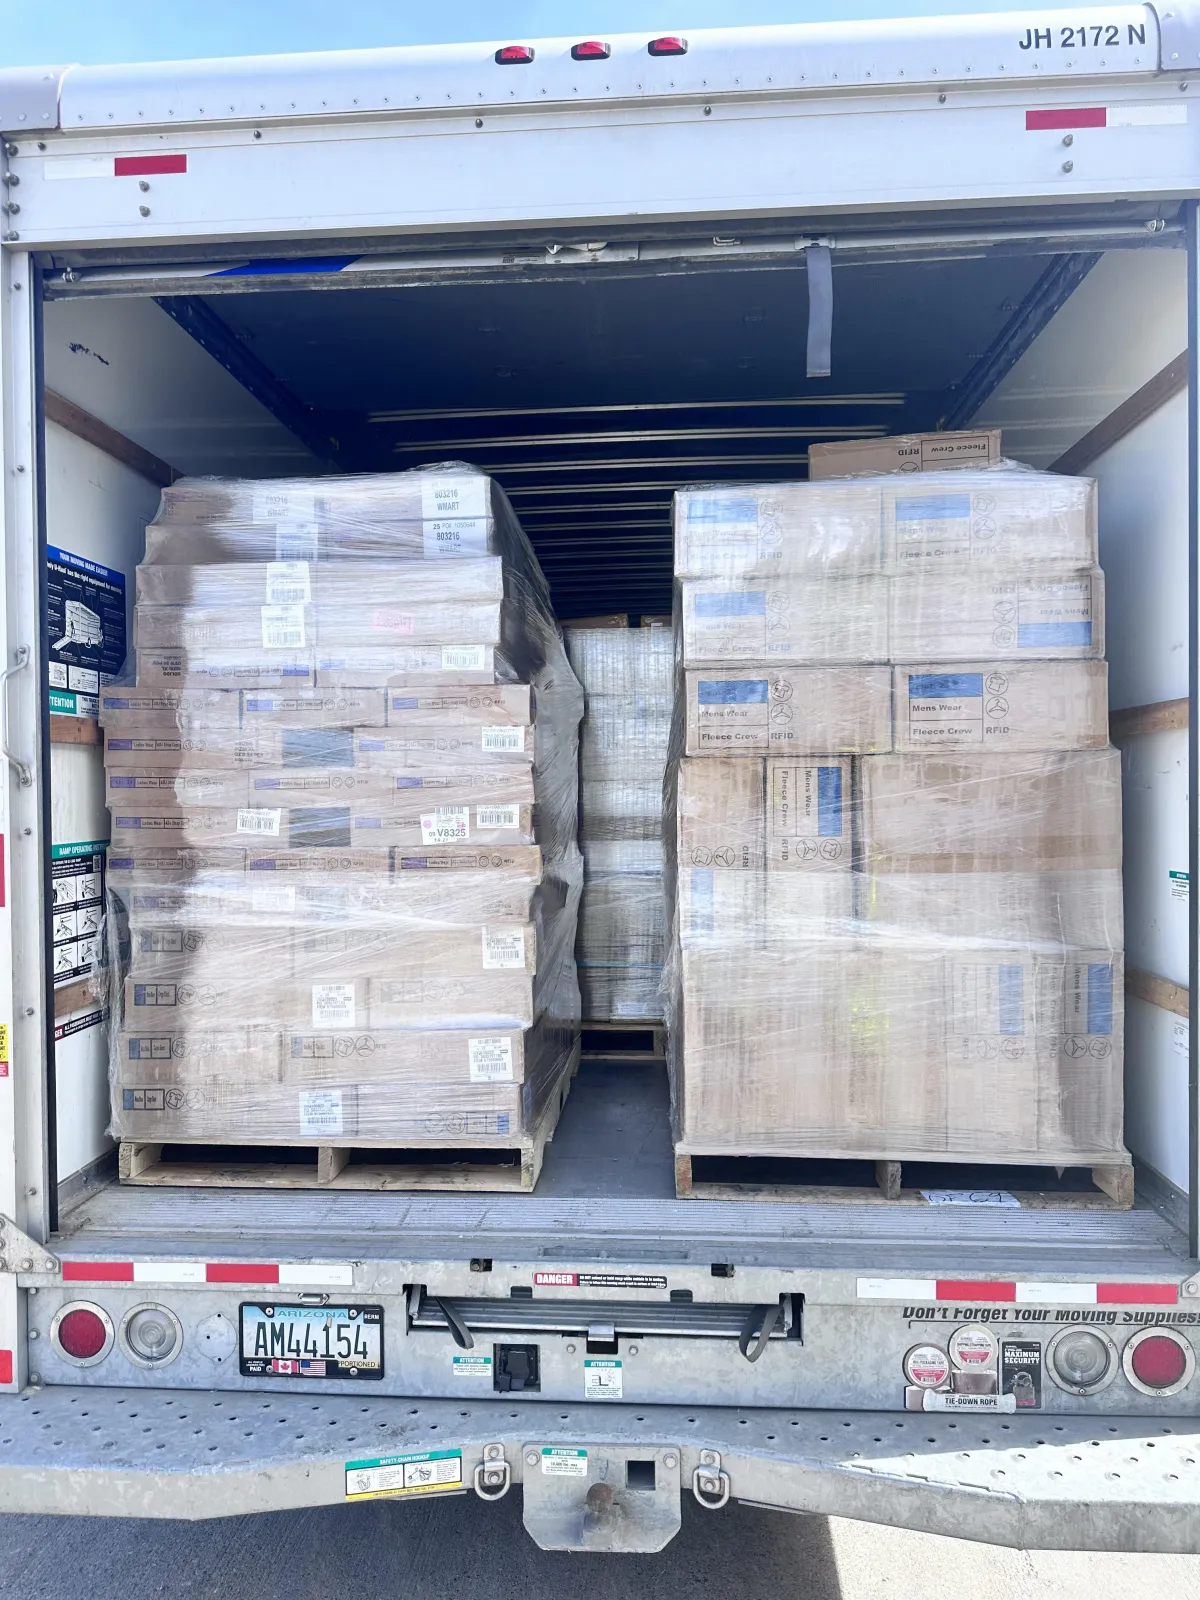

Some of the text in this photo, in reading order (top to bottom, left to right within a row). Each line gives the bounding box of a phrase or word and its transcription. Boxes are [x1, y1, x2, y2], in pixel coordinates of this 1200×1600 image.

[1019, 24, 1146, 50] JH 2172 N
[898, 447, 920, 456] RFID
[931, 443, 986, 453] Fleece Crew
[434, 489, 459, 499] 803216
[436, 501, 460, 511] WMART
[436, 531, 460, 541] 803216
[912, 703, 962, 712] Mens Wear
[912, 727, 973, 735] Fleece Crew
[985, 726, 1010, 735] RFID
[702, 732, 758, 741] Fleece Crew
[771, 732, 794, 740] RFID
[804, 770, 812, 817] Mens Wear
[436, 828, 466, 837] V8325
[1074, 967, 1082, 1014] Mens Wear
[536, 1273, 573, 1285] DANGER
[277, 1310, 347, 1319] ARIZONA
[902, 1306, 949, 1320] Don't
[953, 1307, 1009, 1324] Forget
[1013, 1308, 1051, 1321] Your
[1054, 1309, 1118, 1325] Moving
[254, 1321, 368, 1360] AM44154
[945, 1397, 998, 1406] TIE-DOWN ROPE
